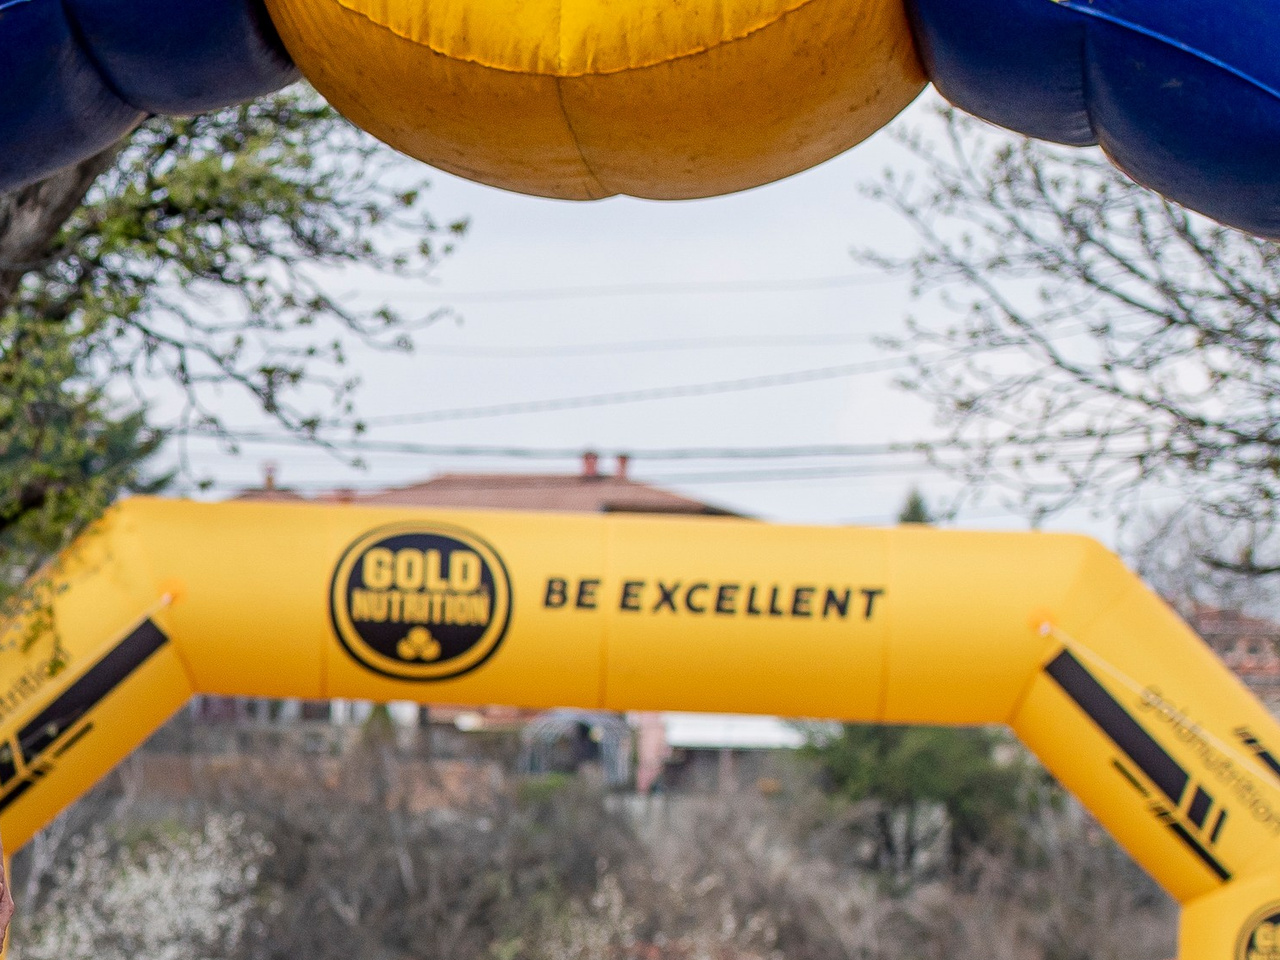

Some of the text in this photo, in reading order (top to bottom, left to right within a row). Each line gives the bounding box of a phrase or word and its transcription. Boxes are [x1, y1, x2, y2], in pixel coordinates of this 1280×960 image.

[362, 546, 484, 593] GOLD
[351, 587, 491, 626] NUTRITION
[543, 578, 885, 621] BE EXCELLENT
